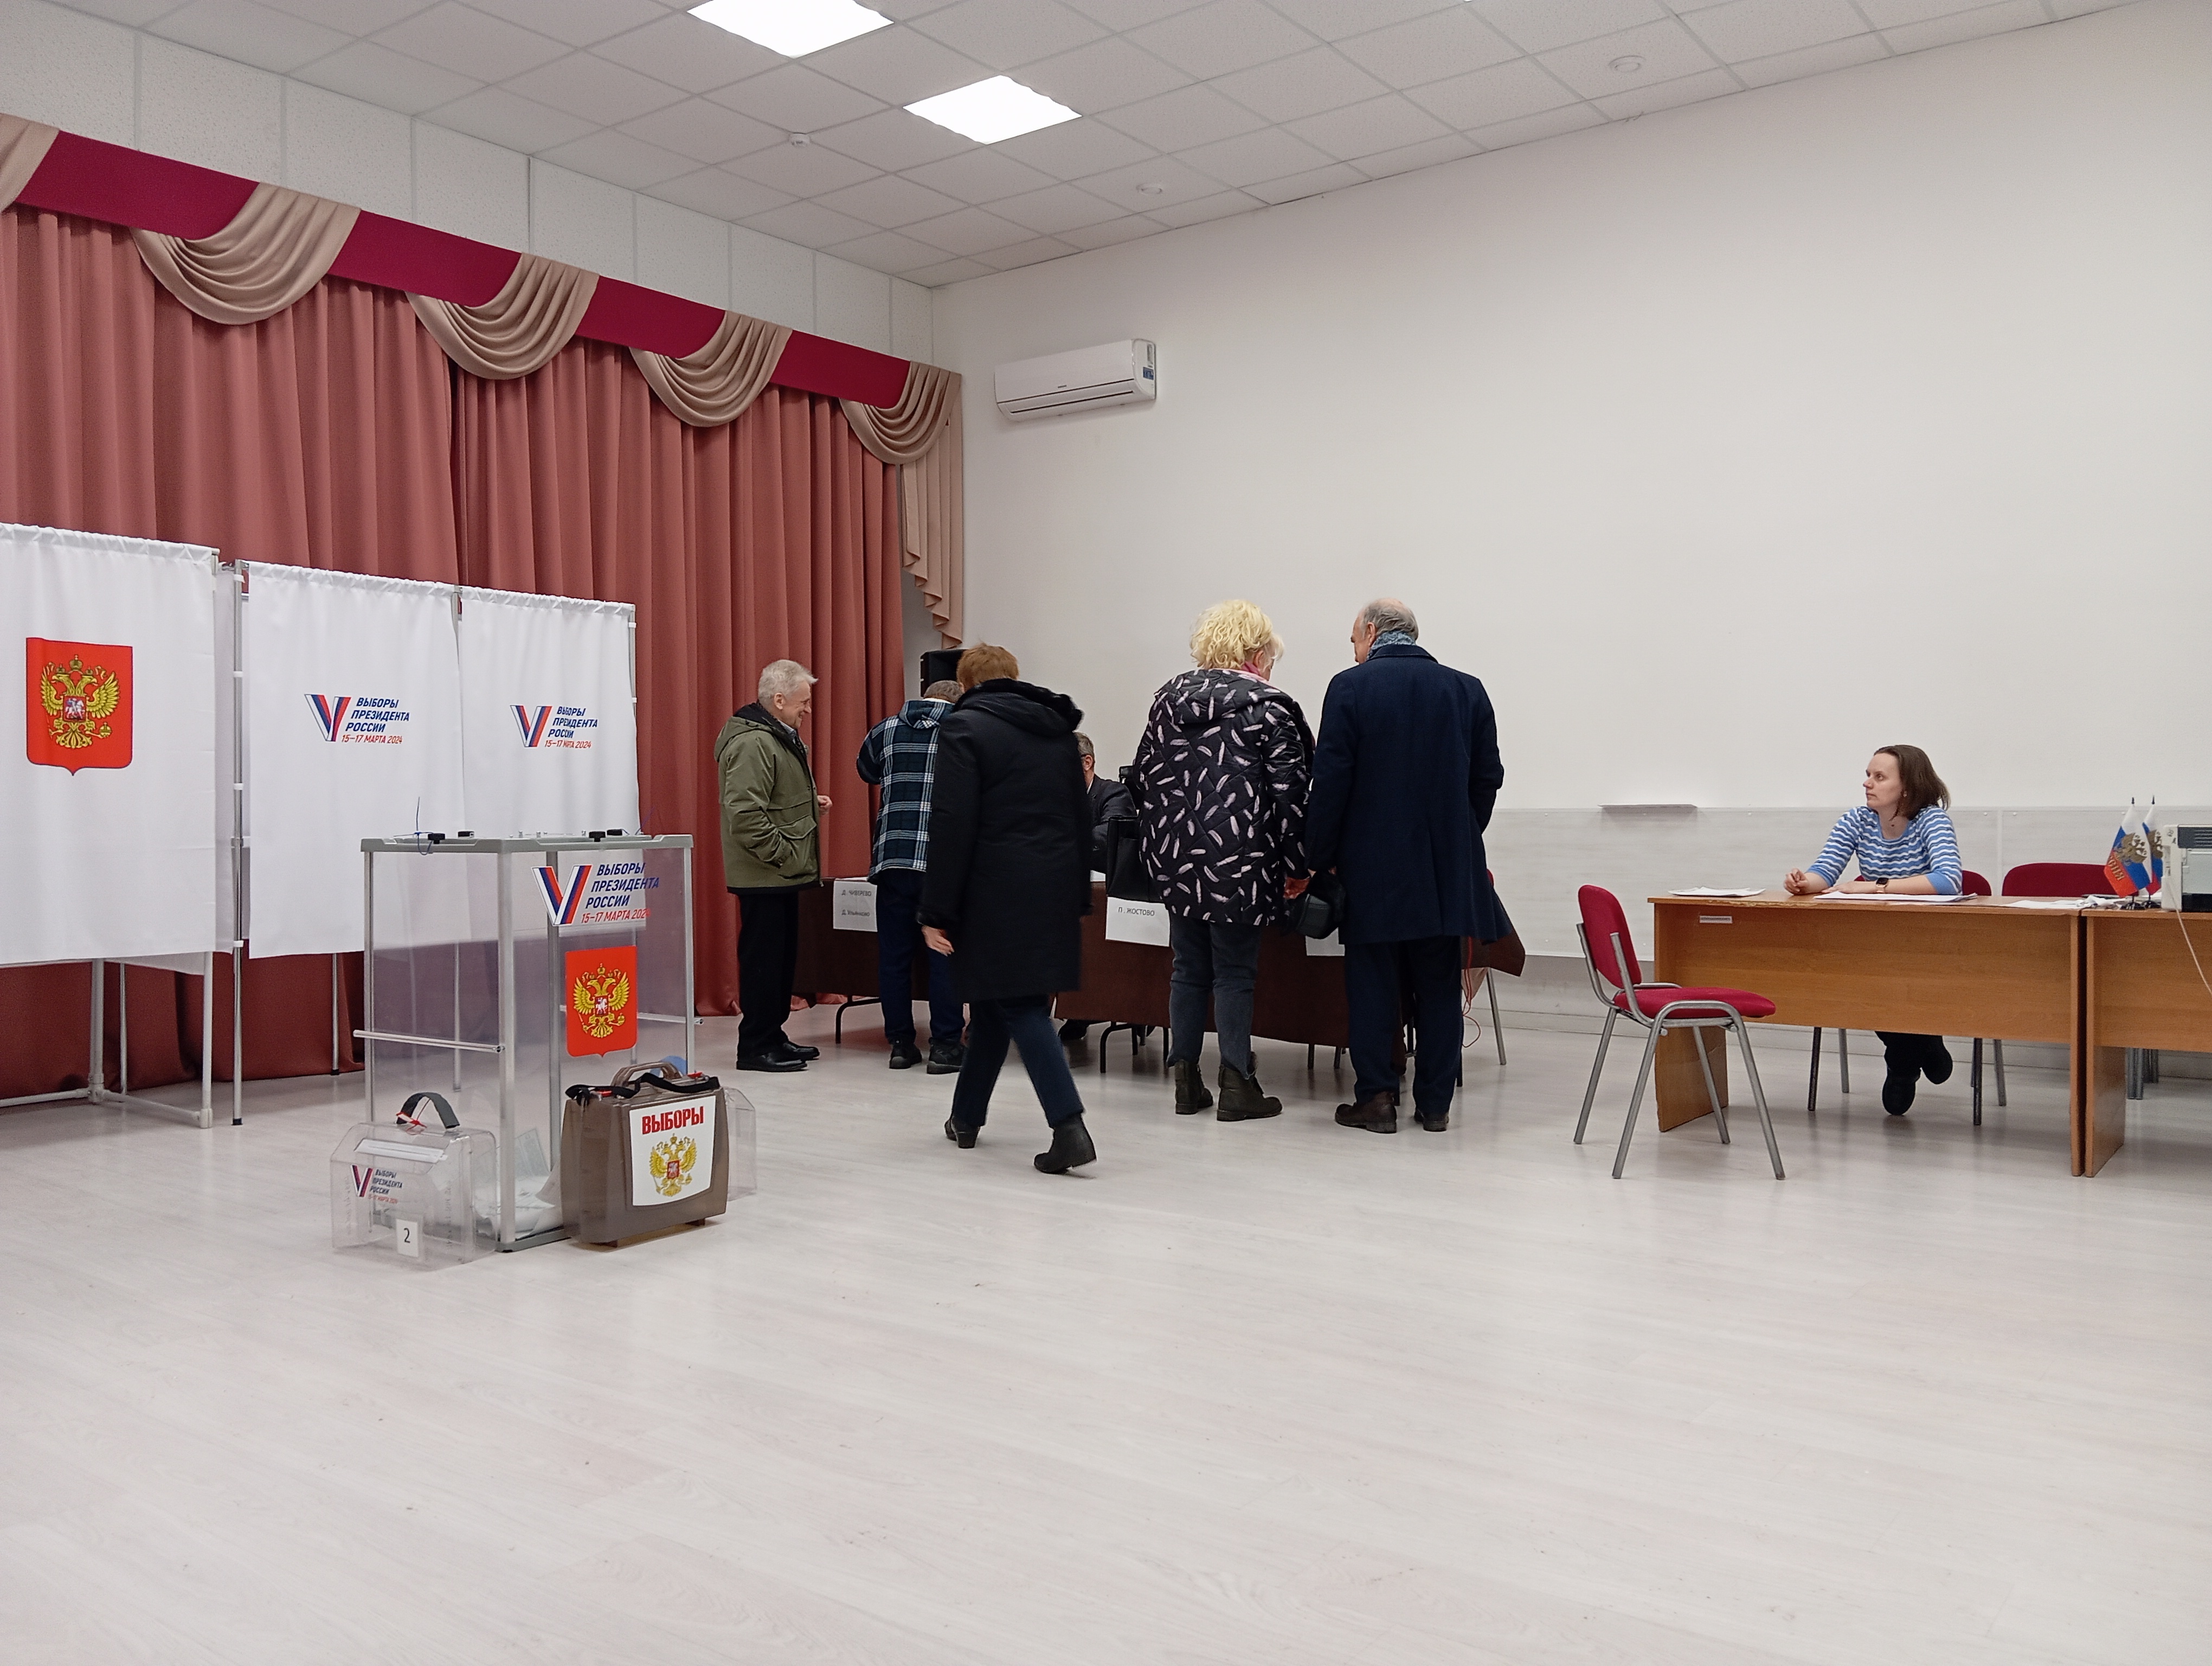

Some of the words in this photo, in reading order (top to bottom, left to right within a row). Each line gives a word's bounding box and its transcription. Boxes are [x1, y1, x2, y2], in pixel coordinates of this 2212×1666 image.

[356, 697, 399, 708] ВЫБОРЫ
[351, 710, 410, 721] ПРЕЗИДЕНТА
[345, 722, 386, 733] РОССИИ
[364, 735, 386, 744] МАРТА
[387, 735, 402, 744] 2024
[597, 863, 646, 876] ВЫБОРЫ
[591, 877, 659, 892] ПРЕЗИДЕНТА
[586, 895, 630, 908] РОССИИ
[604, 909, 631, 921] МАРТА
[1127, 908, 1155, 916] ЖОСТОВО
[642, 1106, 704, 1135] ВЫБОРЫ
[375, 1169, 397, 1179] ВЫБОРЫ
[372, 1177, 403, 1188] ПРЕЗИДЕНТА
[369, 1186, 390, 1195] РОССИИ
[403, 1228, 410, 1244] 2
